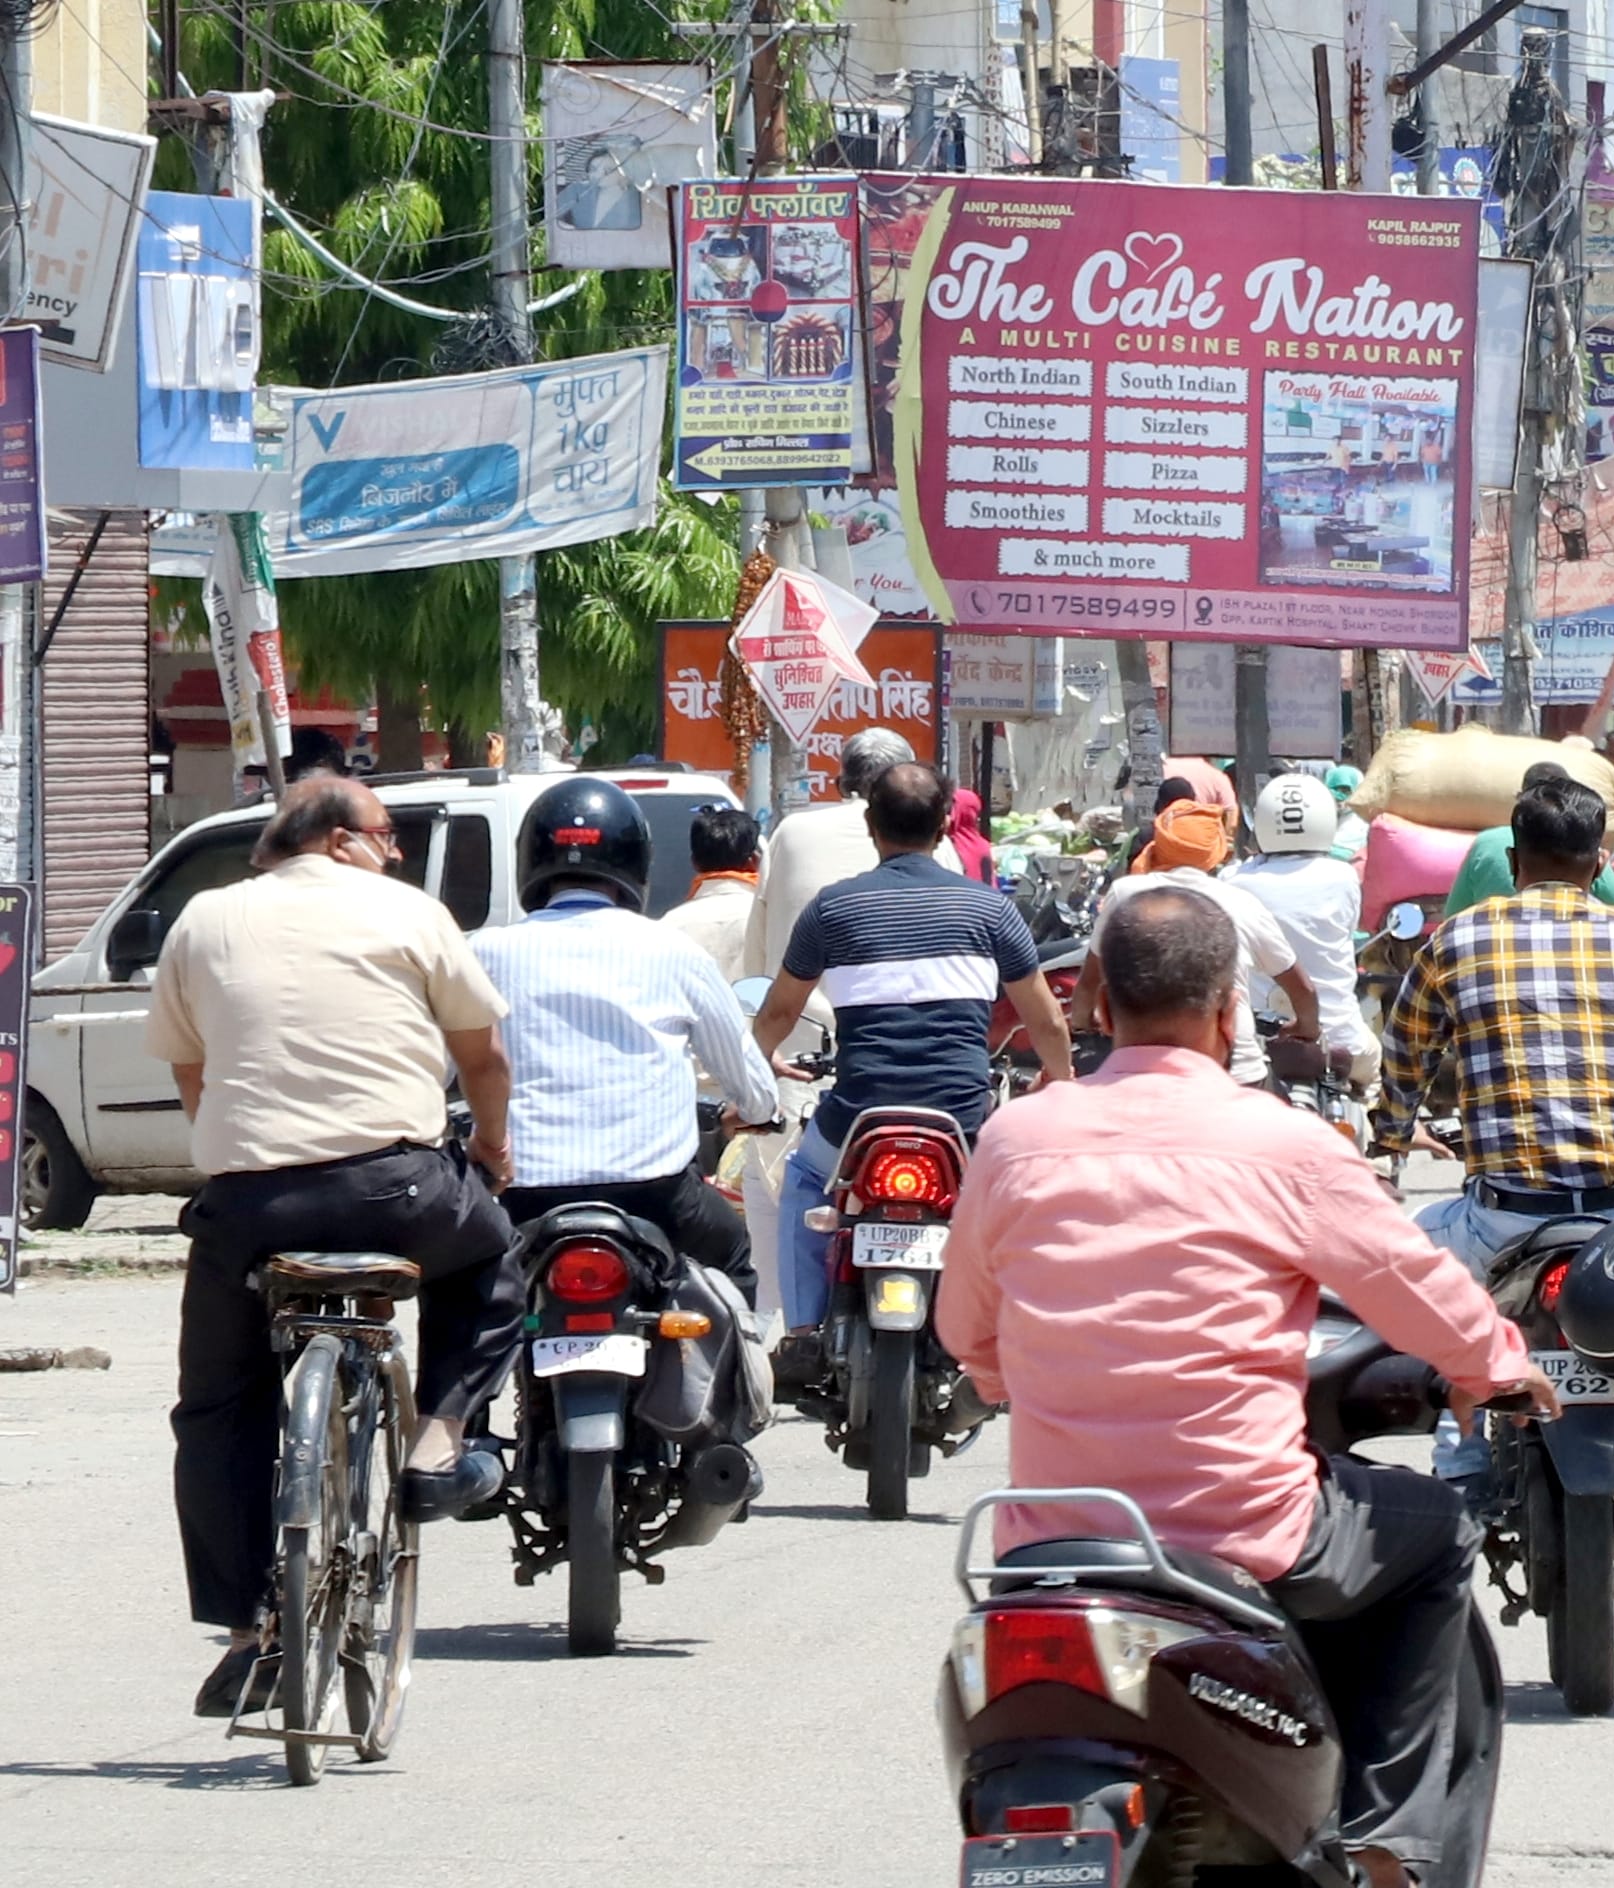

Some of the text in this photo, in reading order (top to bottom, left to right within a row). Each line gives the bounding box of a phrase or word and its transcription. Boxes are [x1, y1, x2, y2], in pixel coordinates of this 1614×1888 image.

[962, 201, 1075, 217] ANUP KARANWAL
[1367, 218, 1462, 234] KAPIL RAJPUT
[1377, 233, 1461, 248] 9058662935
[928, 235, 1465, 343] The Café Nation
[959, 327, 1464, 367] A MULTI CUISINE RESTAURANT
[961, 366, 1081, 386] North Indian
[1120, 371, 1238, 394] South Indian
[1279, 379, 1441, 403] Party Hall Available
[984, 410, 1057, 431] Chinese
[1141, 416, 1210, 437] Sizzlers
[992, 454, 1039, 473] Rolls
[1151, 462, 1199, 481] Pizza
[553, 455, 609, 494] चाय
[361, 479, 434, 508] बिजनौर
[970, 500, 1066, 522] Smoothies
[1133, 507, 1222, 528] Mocktails
[1033, 549, 1156, 570] & much more
[997, 593, 1176, 618] 7017589499
[781, 691, 816, 711] उपहार
[879, 668, 934, 727] सिंह
[1281, 784, 1305, 834] 1901
[895, 1140, 921, 1150] Hero
[1542, 1360, 1568, 1376] UP
[971, 1866, 1106, 1887] ZERO EMISSION
